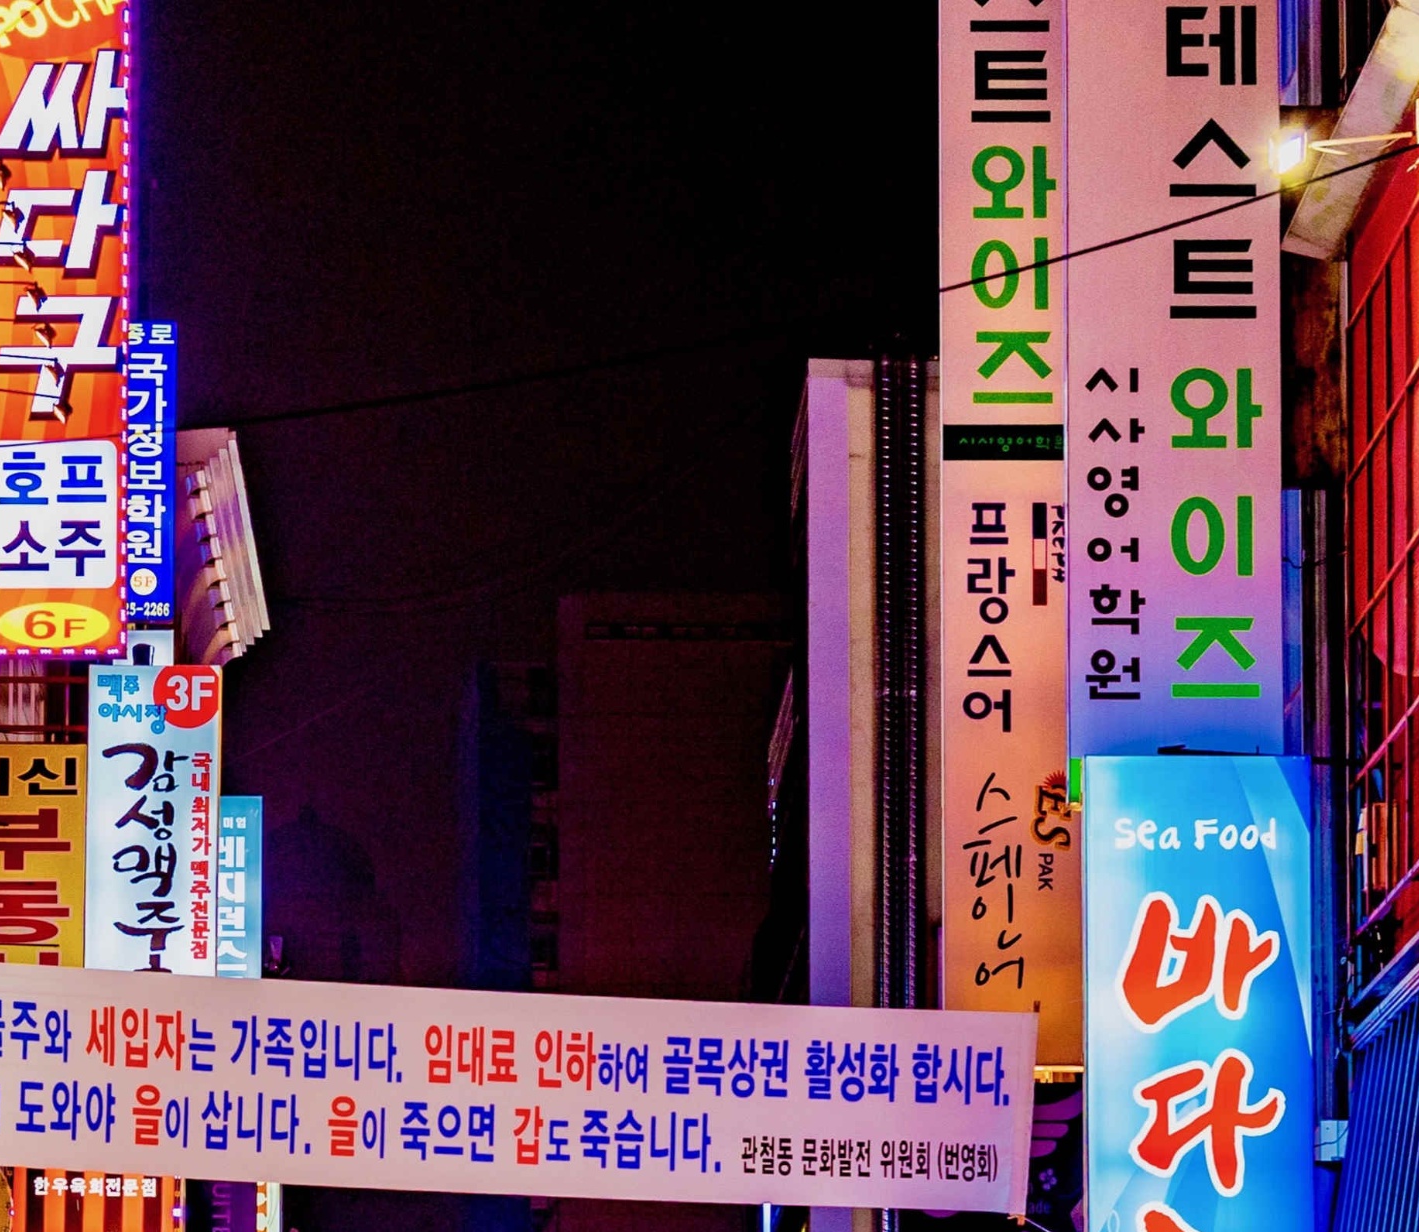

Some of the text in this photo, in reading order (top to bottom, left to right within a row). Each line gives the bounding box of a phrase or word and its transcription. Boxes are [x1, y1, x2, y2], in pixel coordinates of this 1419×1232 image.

[1165, 5, 1264, 699] 테스트와이즈
[127, 352, 167, 565] 국가정보학원
[0, 520, 106, 577] 소주
[1084, 367, 1146, 701] 시사영어학원
[23, 610, 88, 640] 6F
[963, 502, 1016, 732] 프랑스어
[97, 674, 139, 702] 맥주
[166, 676, 214, 711] 3F
[98, 704, 167, 734] 야시장
[191, 752, 212, 791] 국내
[1115, 818, 1277, 850] Sea Food
[963, 772, 1024, 989] 스페인어
[85, 1006, 217, 1072] 세입자는
[230, 1017, 403, 1083] 가족입니다.
[424, 1024, 518, 1087] 임대료
[534, 1030, 649, 1093] 인하하여
[663, 1036, 789, 1099] 골목상권
[804, 1040, 899, 1102] 활성화
[912, 1045, 1010, 1106] 합시다.
[16, 1080, 116, 1143] 도와야
[132, 1084, 190, 1148] 을이
[201, 1091, 312, 1155] 삽니다.
[327, 1096, 386, 1160] 을이
[400, 1101, 496, 1163] 죽으면
[513, 1106, 571, 1166] 갑도
[580, 1109, 722, 1173] 죽습니다.
[741, 1136, 998, 1183] 관철동 문화발전 위원회 (번영회)
